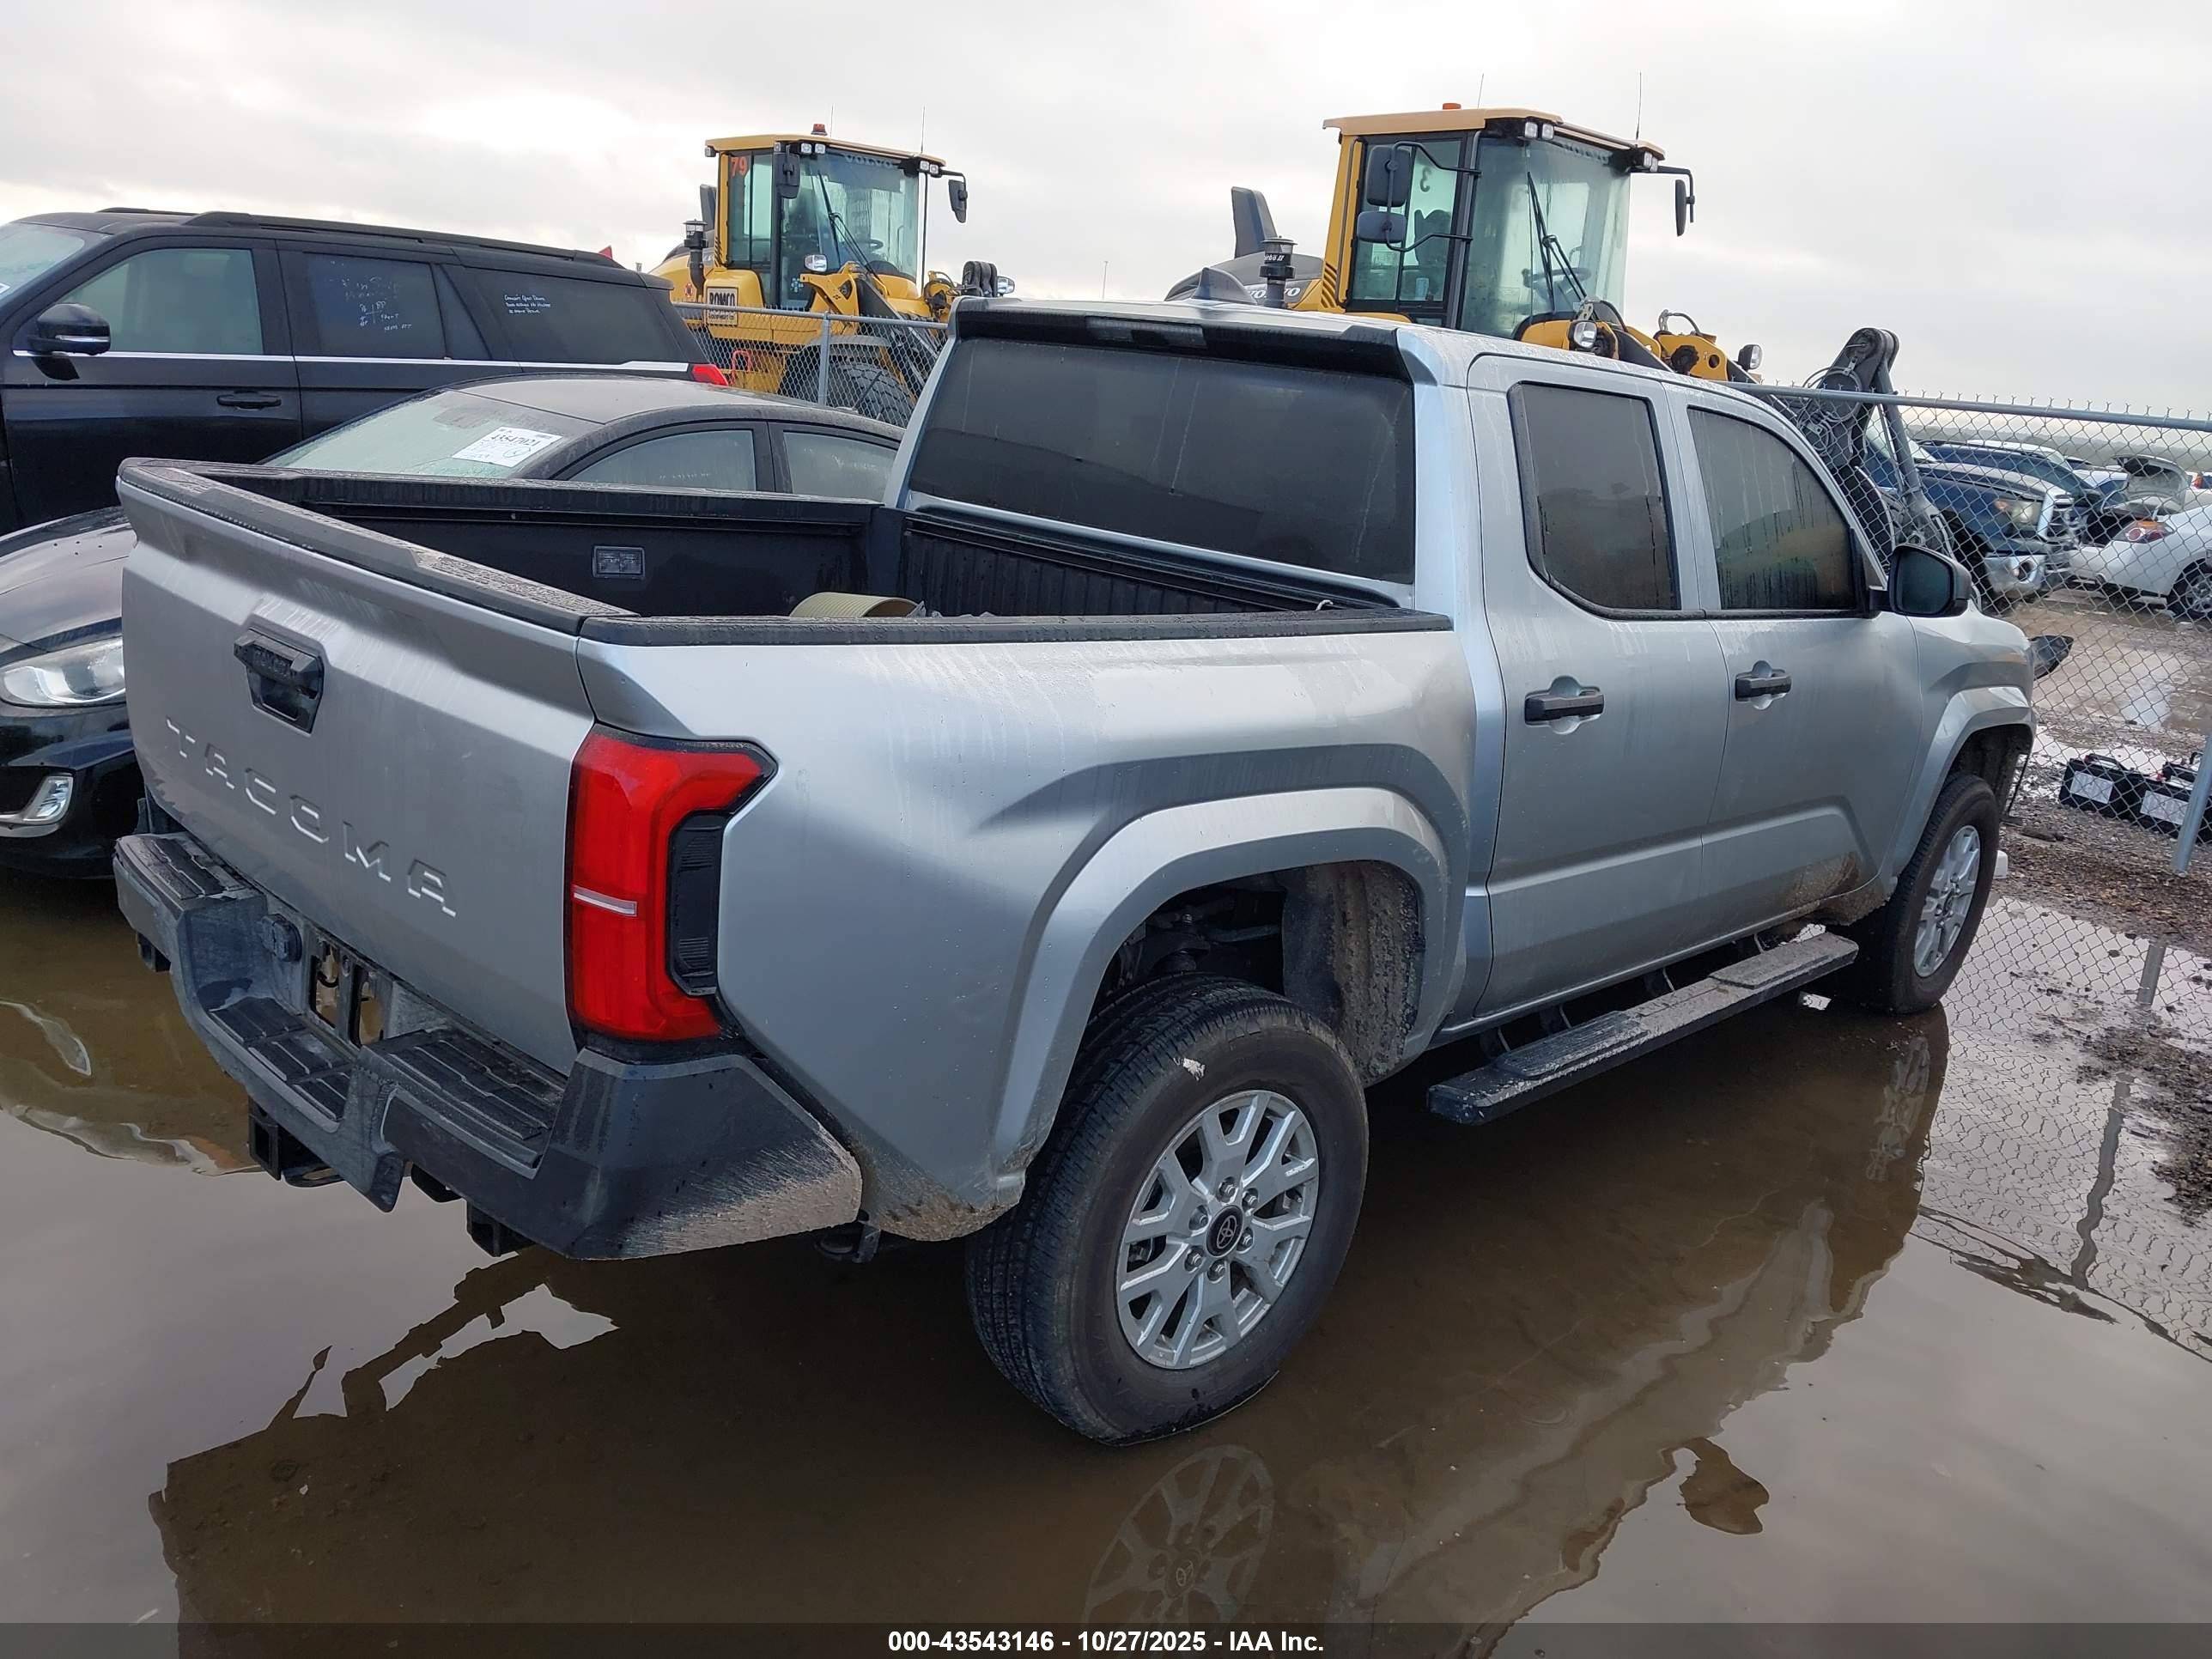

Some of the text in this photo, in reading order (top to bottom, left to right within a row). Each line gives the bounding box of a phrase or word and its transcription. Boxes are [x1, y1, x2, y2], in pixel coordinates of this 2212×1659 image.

[731, 156, 748, 177] 79
[845, 154, 893, 169] VOLVO
[166, 716, 456, 917] TACOMA
